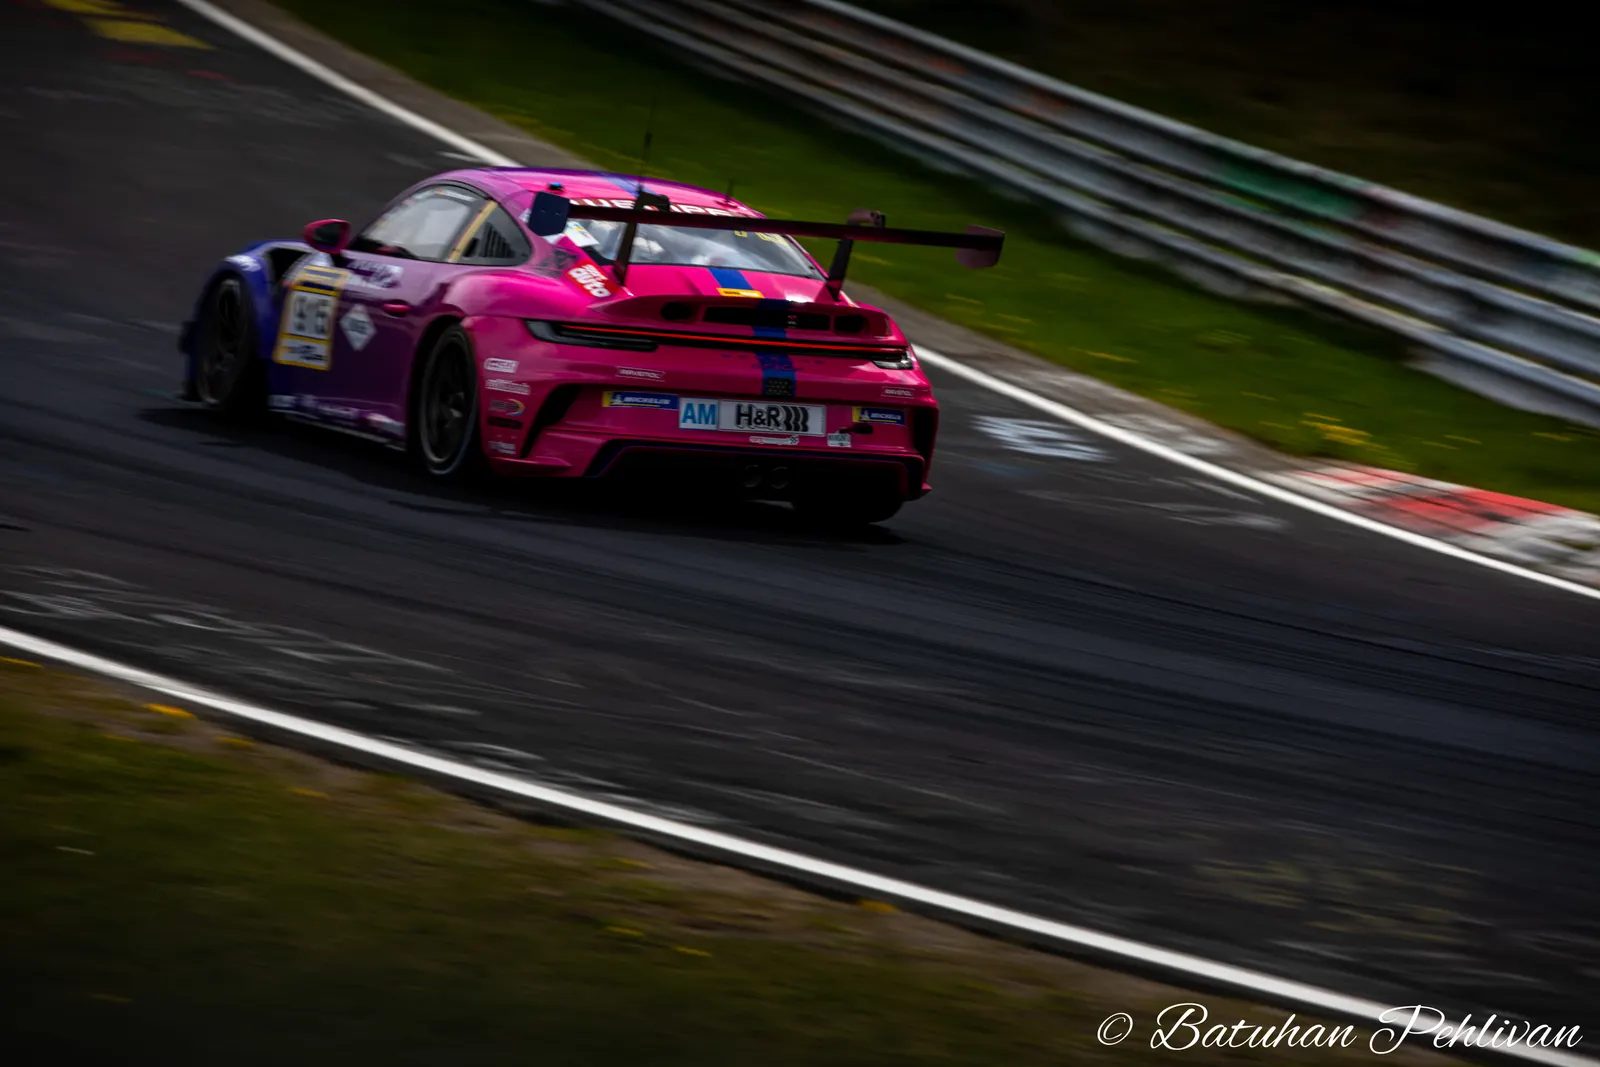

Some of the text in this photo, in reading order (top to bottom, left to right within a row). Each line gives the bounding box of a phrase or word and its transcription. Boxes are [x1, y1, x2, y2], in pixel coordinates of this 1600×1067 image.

[567, 267, 612, 298] auto
[623, 396, 672, 406] MICHELIN
[681, 402, 783, 429] AM H&R
